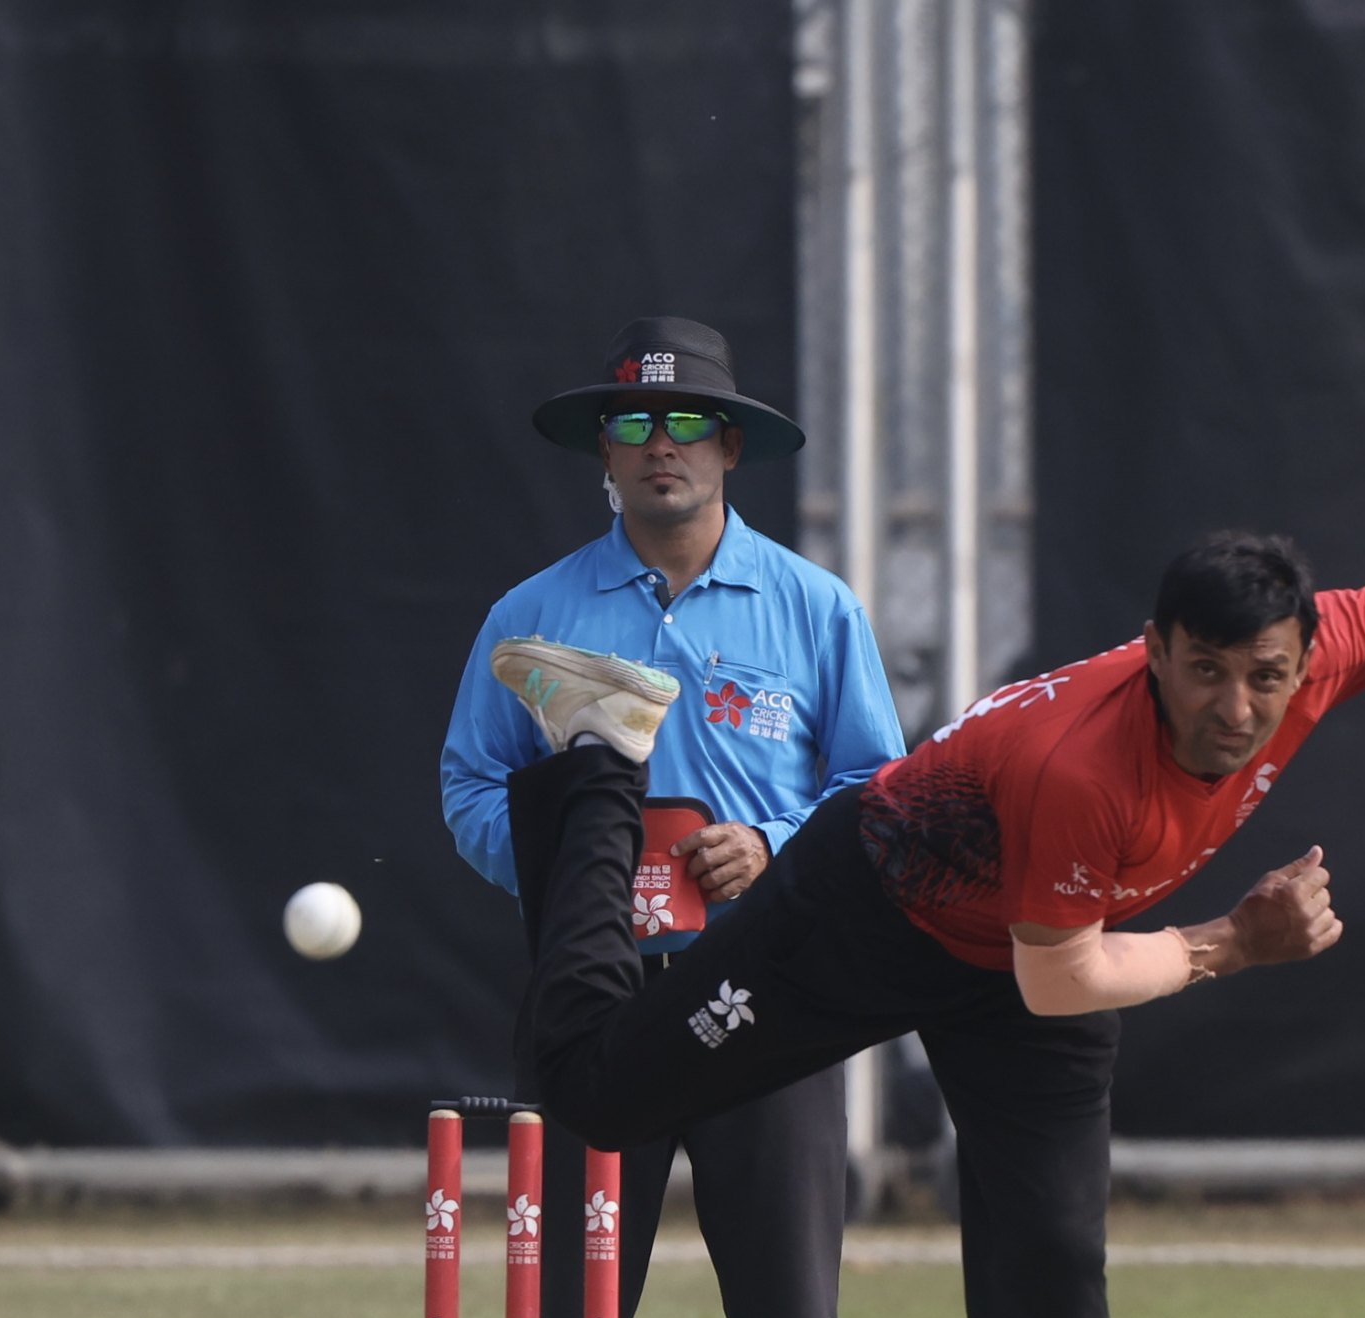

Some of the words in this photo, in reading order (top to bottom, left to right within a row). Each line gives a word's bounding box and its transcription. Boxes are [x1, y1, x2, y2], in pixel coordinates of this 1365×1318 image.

[641, 352, 675, 364] ACO
[752, 690, 792, 712] ACO
[632, 880, 671, 889] CRICKET
